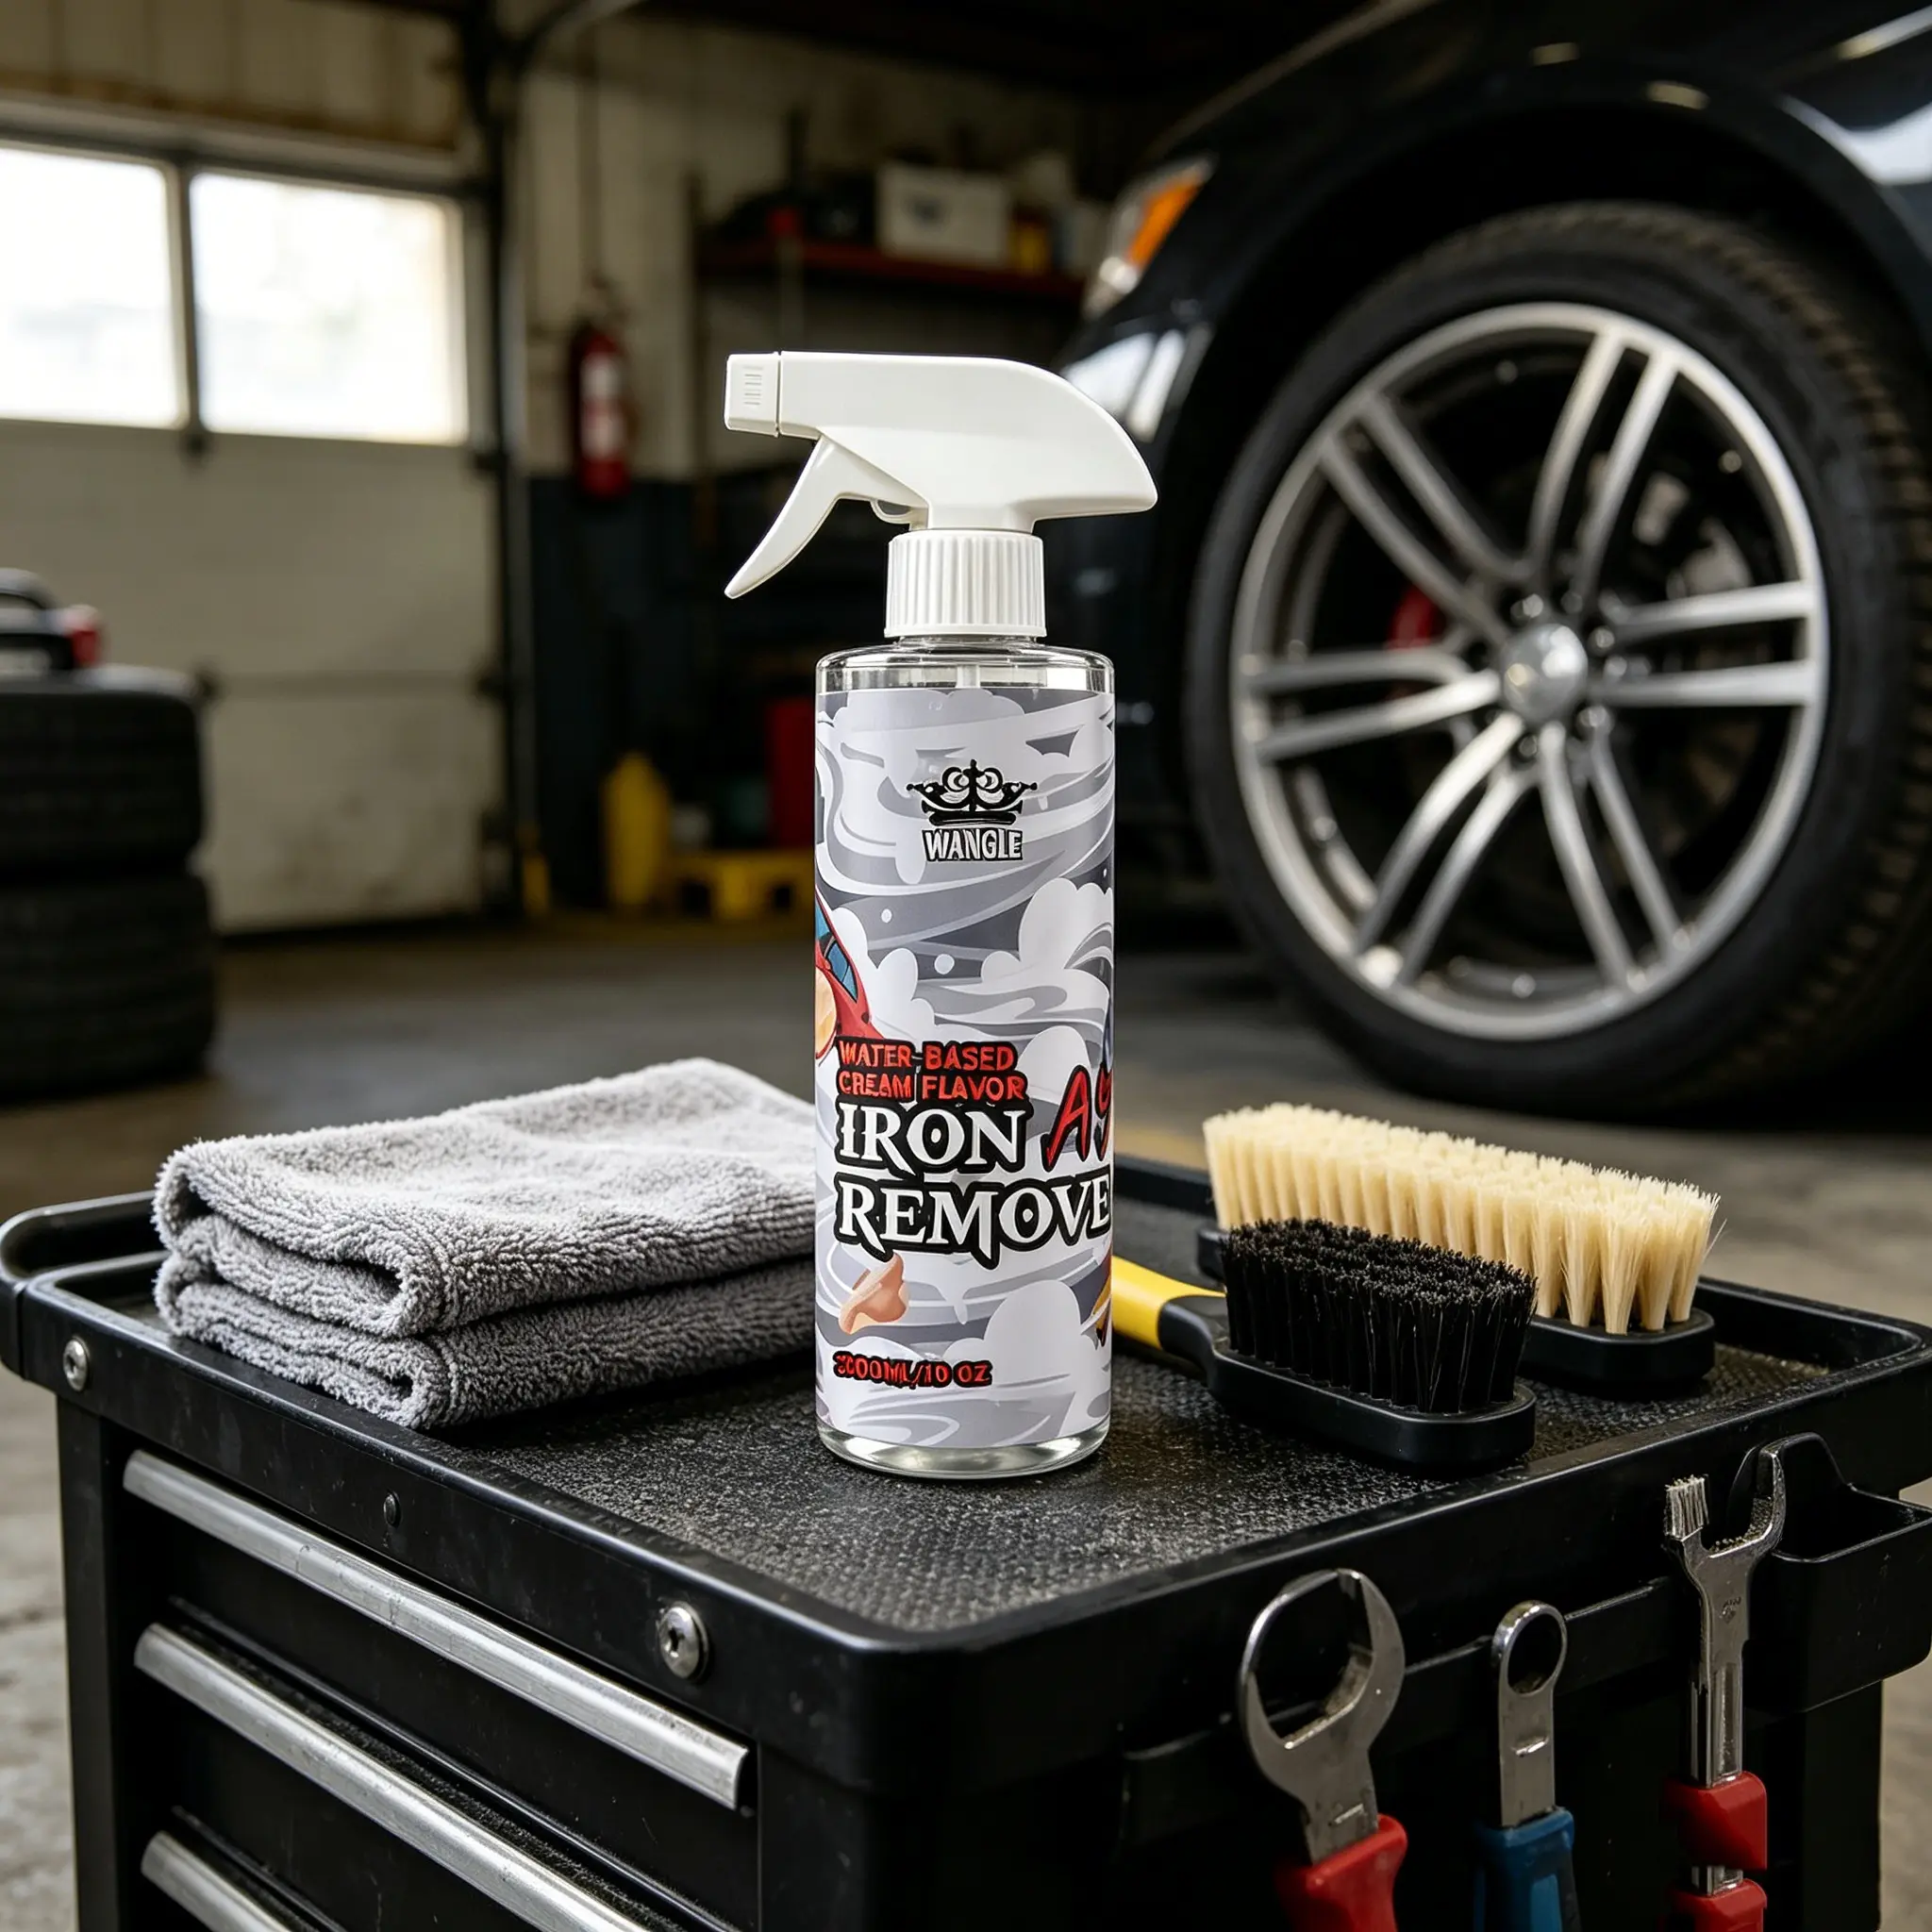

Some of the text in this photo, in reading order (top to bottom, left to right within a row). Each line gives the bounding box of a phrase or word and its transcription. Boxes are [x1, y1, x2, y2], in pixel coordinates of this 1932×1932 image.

[923, 829, 1023, 861] WANGLE
[838, 1071, 1026, 1102] CREAM FLAVOR
[837, 1101, 1028, 1175] IRON
[837, 1175, 1110, 1259] REMOVE
[957, 1362, 991, 1385] OZ
